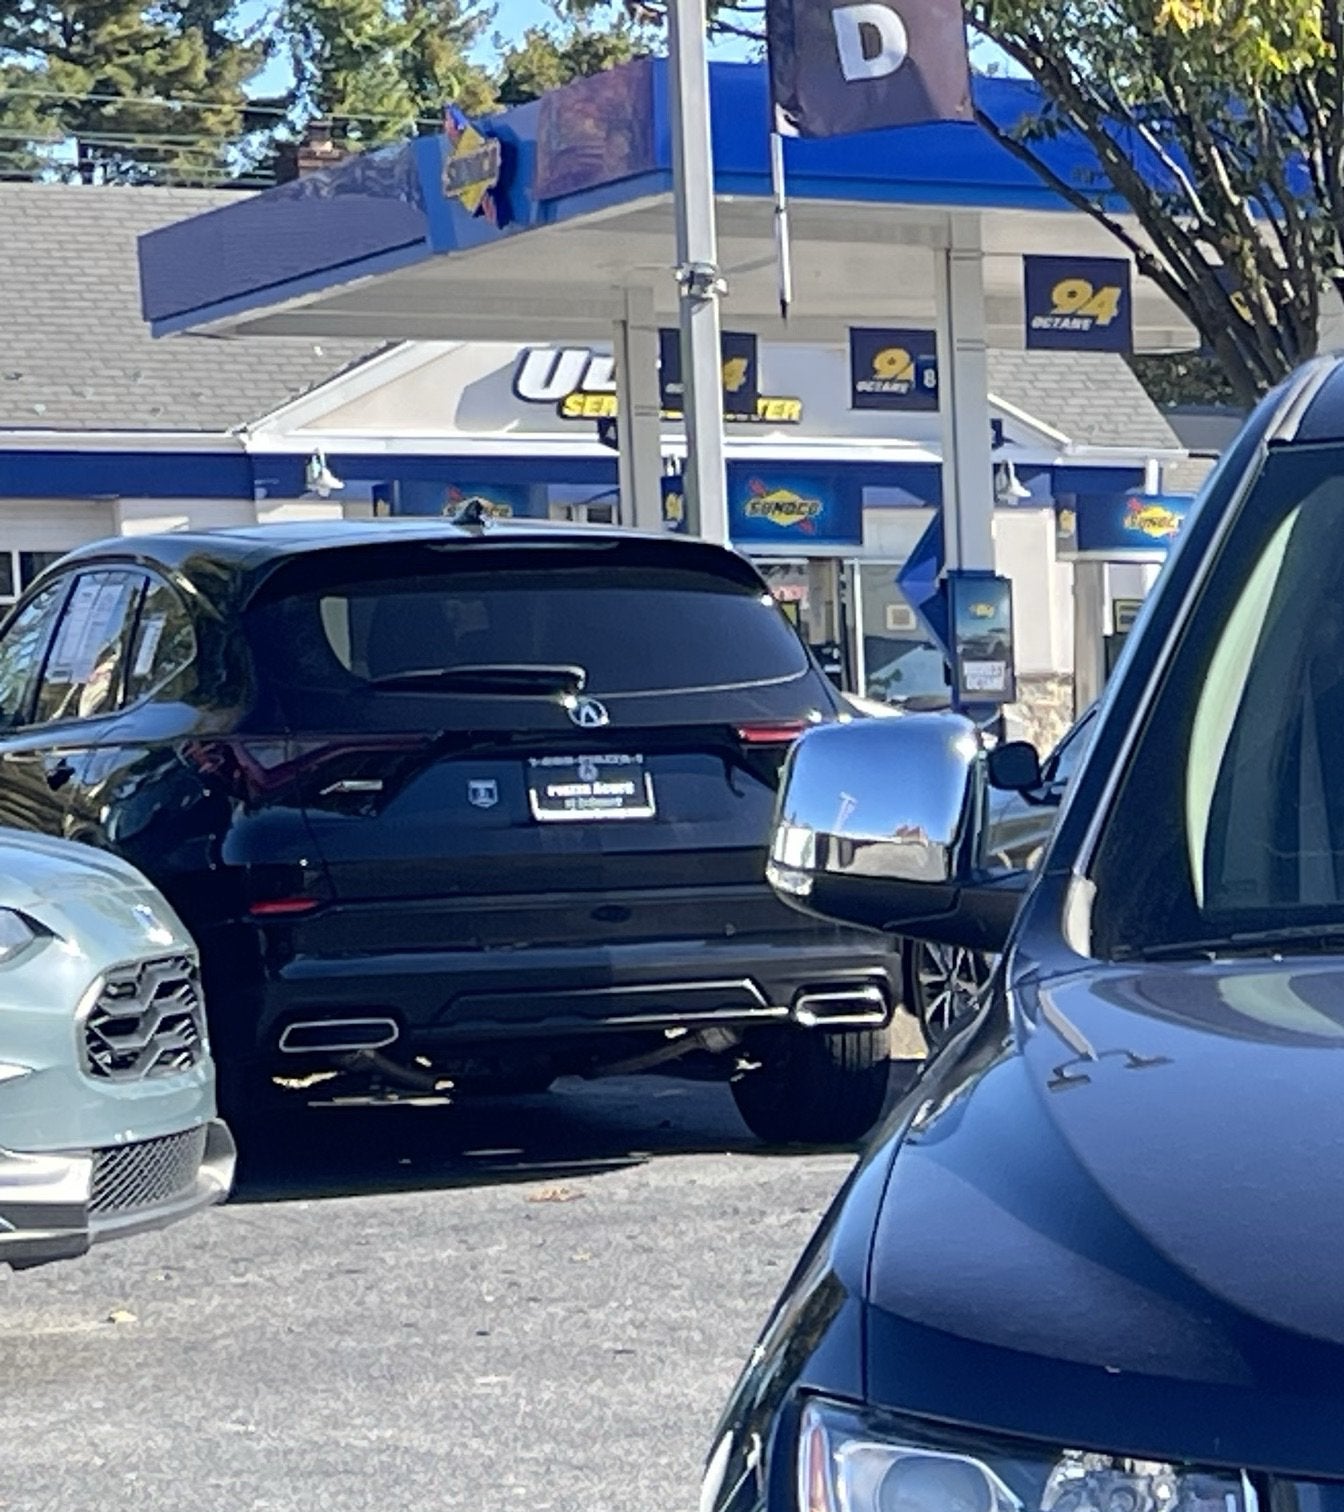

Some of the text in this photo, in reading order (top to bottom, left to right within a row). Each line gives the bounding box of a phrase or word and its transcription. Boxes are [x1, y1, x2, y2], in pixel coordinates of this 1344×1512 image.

[833, 3, 908, 81] D
[1052, 278, 1121, 326] 94
[1031, 316, 1093, 331] OCTANE
[749, 500, 821, 516] SUNOCO
